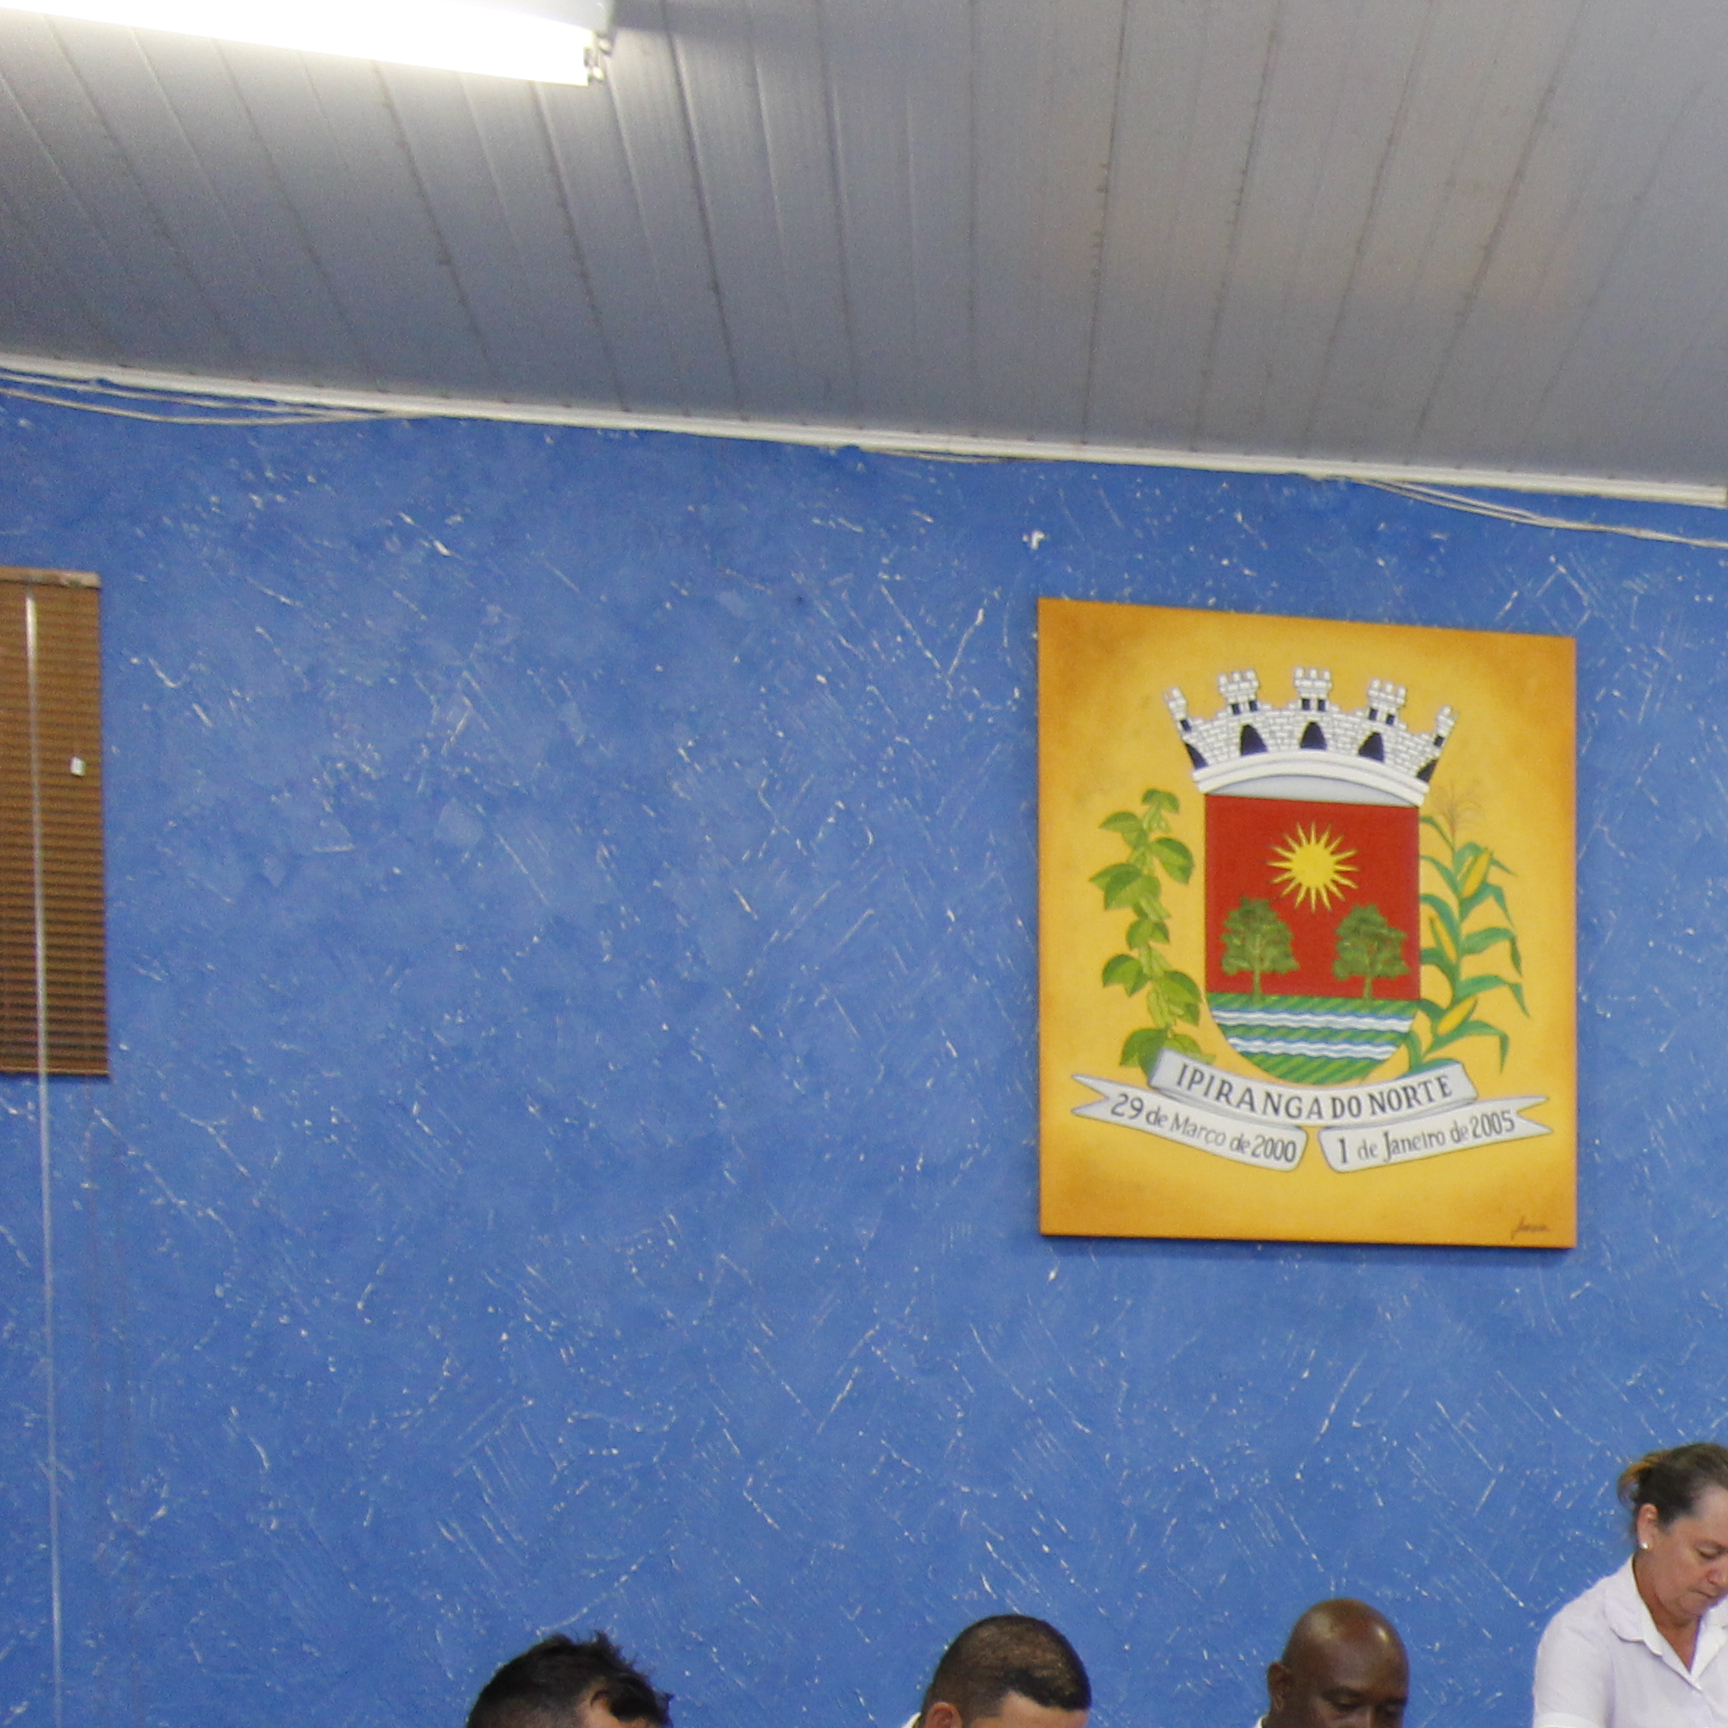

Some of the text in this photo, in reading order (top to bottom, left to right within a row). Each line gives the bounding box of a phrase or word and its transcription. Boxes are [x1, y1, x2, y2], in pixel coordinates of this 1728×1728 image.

[1175, 1062, 1454, 1121] IPIRANGA DO NORTE
[1110, 1093, 1298, 1163] 29 de Março de 2000
[1338, 1110, 1517, 1165] 1 de Janeiro de 2005
